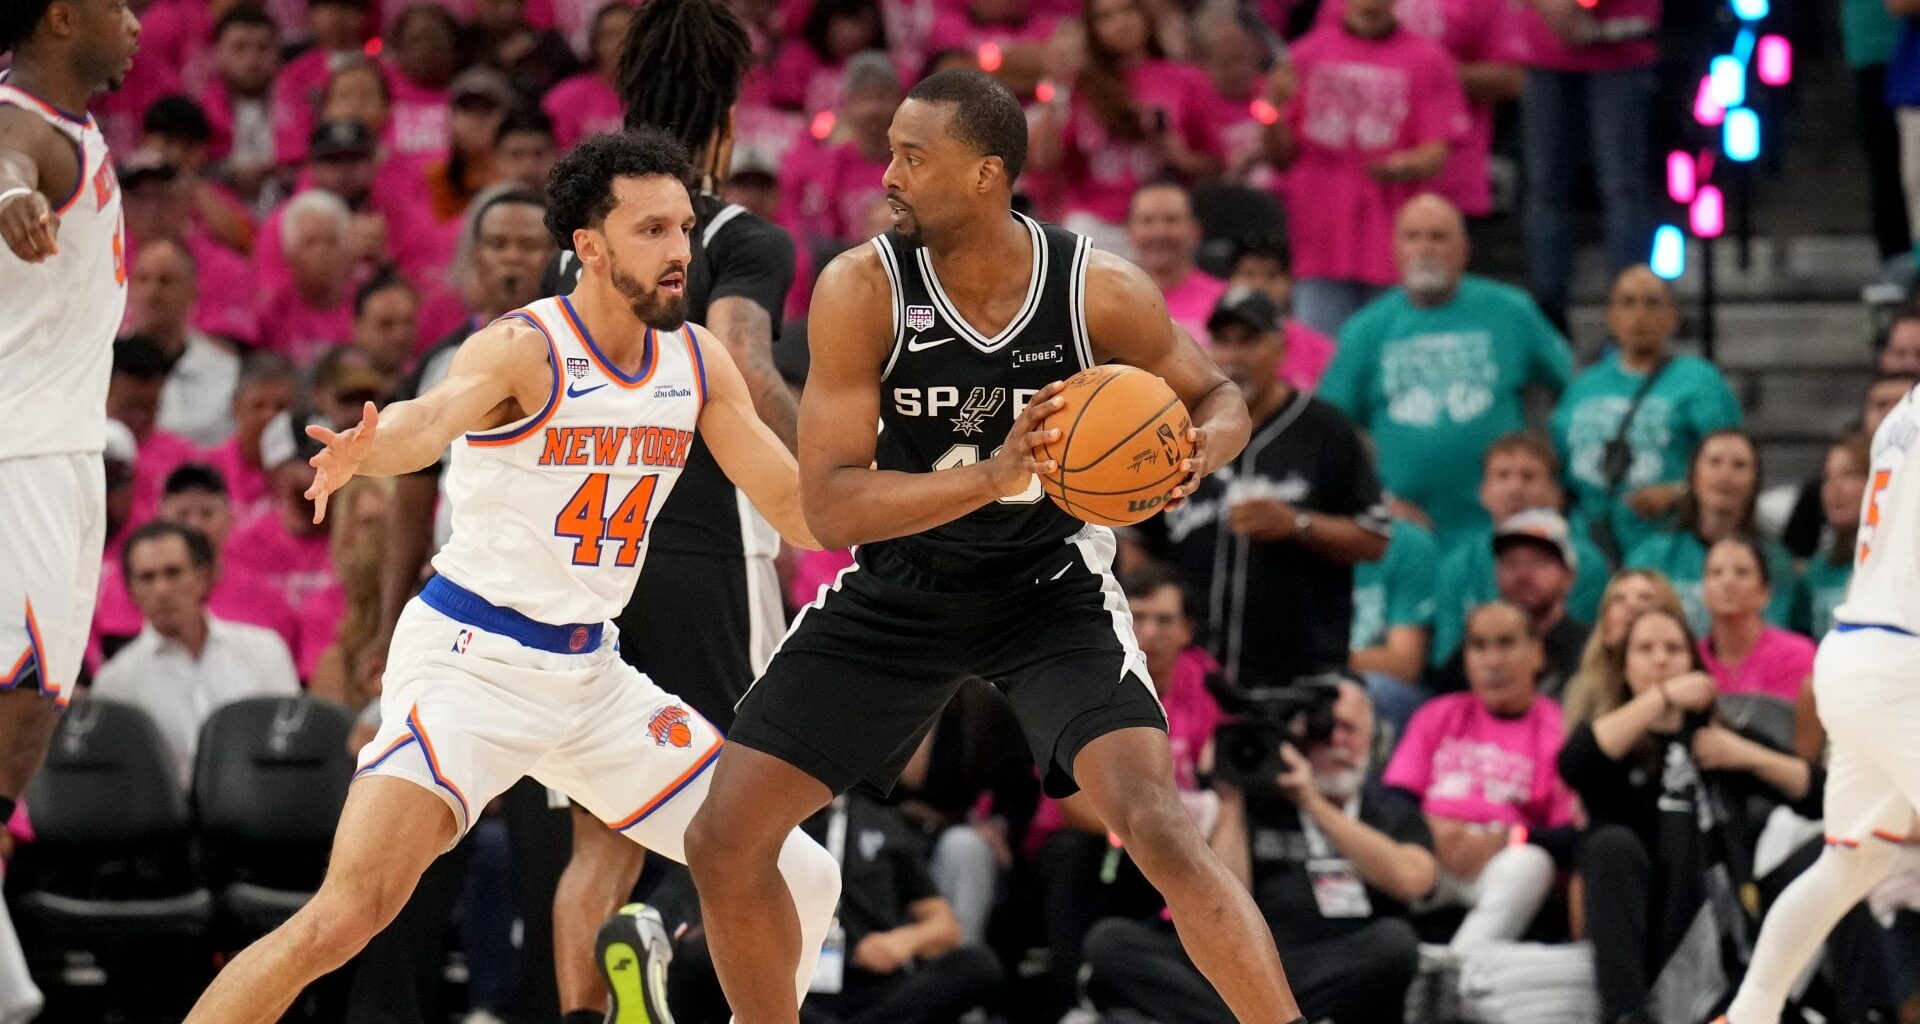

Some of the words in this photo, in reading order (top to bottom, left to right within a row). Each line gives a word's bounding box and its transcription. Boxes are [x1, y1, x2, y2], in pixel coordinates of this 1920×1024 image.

[909, 318, 932, 326] 250
[1019, 350, 1057, 363] LEDGER
[538, 426, 628, 466] NEW
[627, 426, 695, 468] YORK
[554, 472, 660, 567] 44
